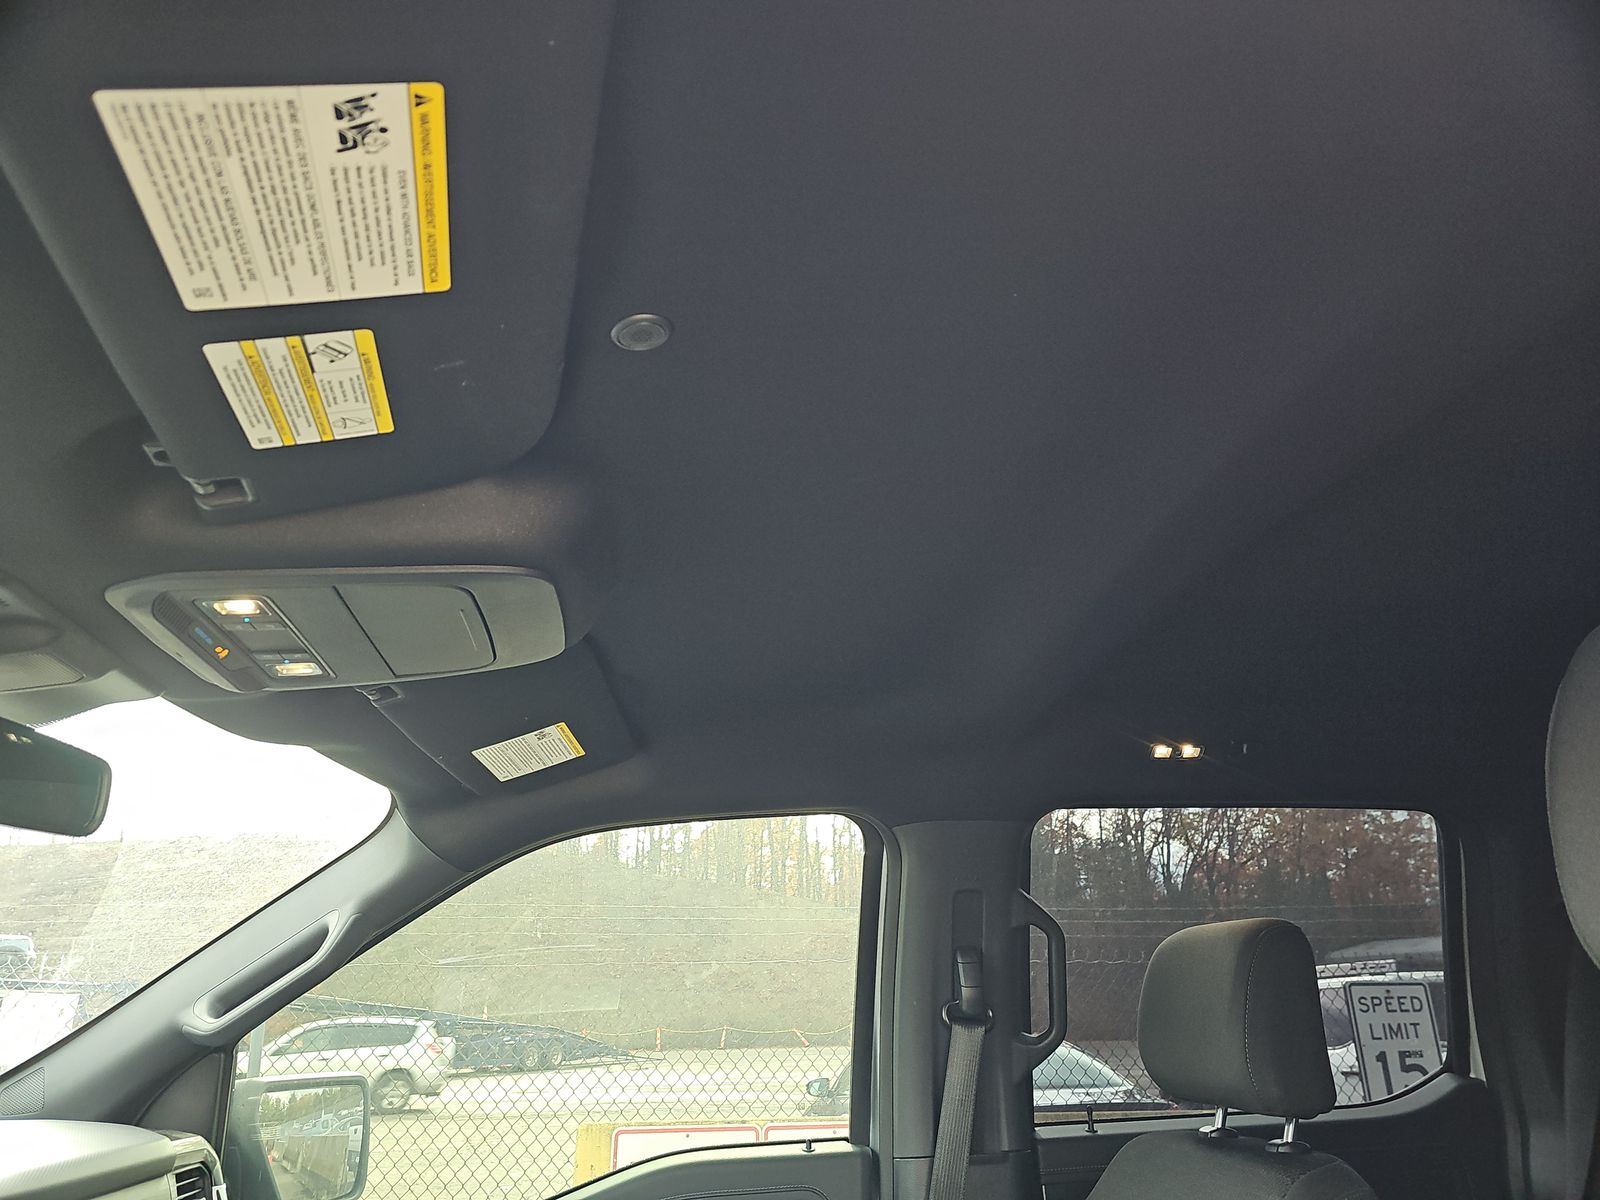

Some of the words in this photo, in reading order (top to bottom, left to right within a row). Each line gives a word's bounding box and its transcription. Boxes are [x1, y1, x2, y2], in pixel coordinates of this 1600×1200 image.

[1358, 996, 1423, 1013] SPEED
[1369, 1023, 1420, 1041] LIMIT
[1376, 1050, 1429, 1095] 15
